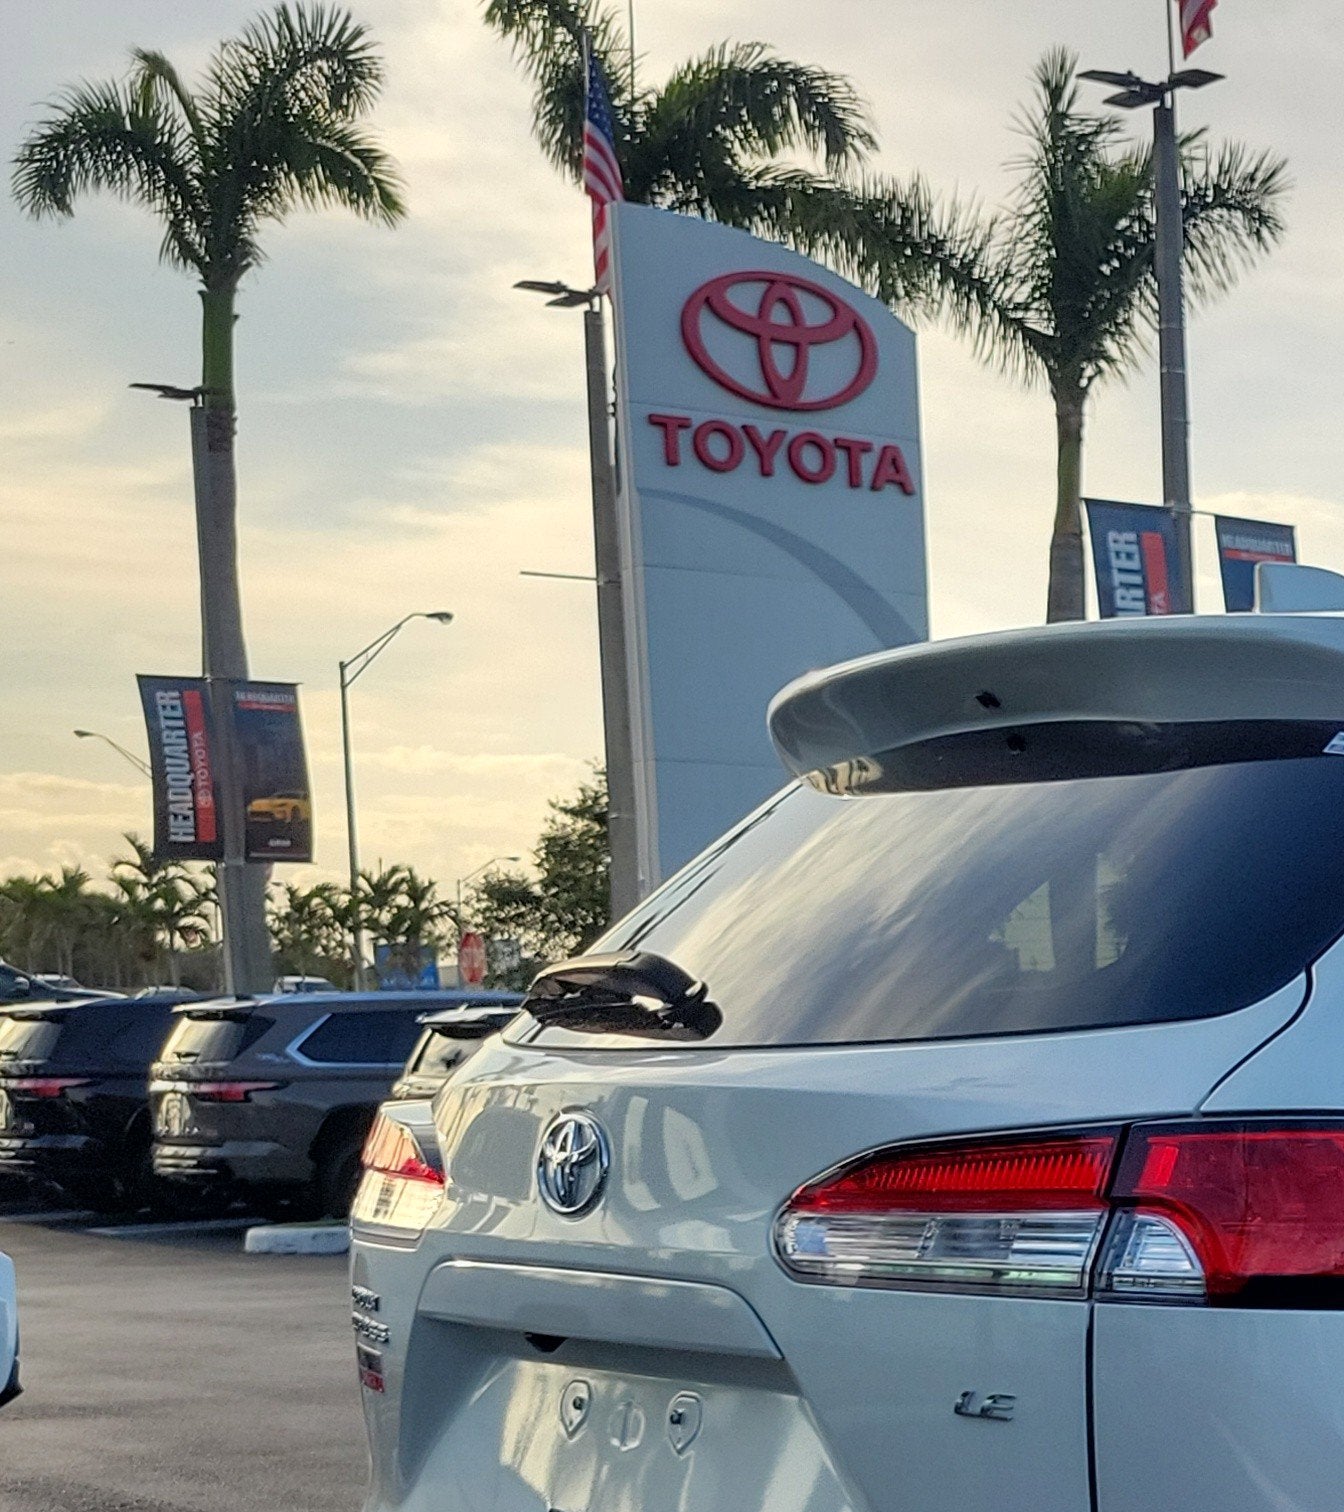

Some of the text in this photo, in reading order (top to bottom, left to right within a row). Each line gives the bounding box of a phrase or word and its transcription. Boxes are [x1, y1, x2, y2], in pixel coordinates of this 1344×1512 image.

[648, 413, 915, 495] TOYOTA
[154, 690, 196, 842] HEADQUARTER
[954, 1390, 1017, 1422] LE
